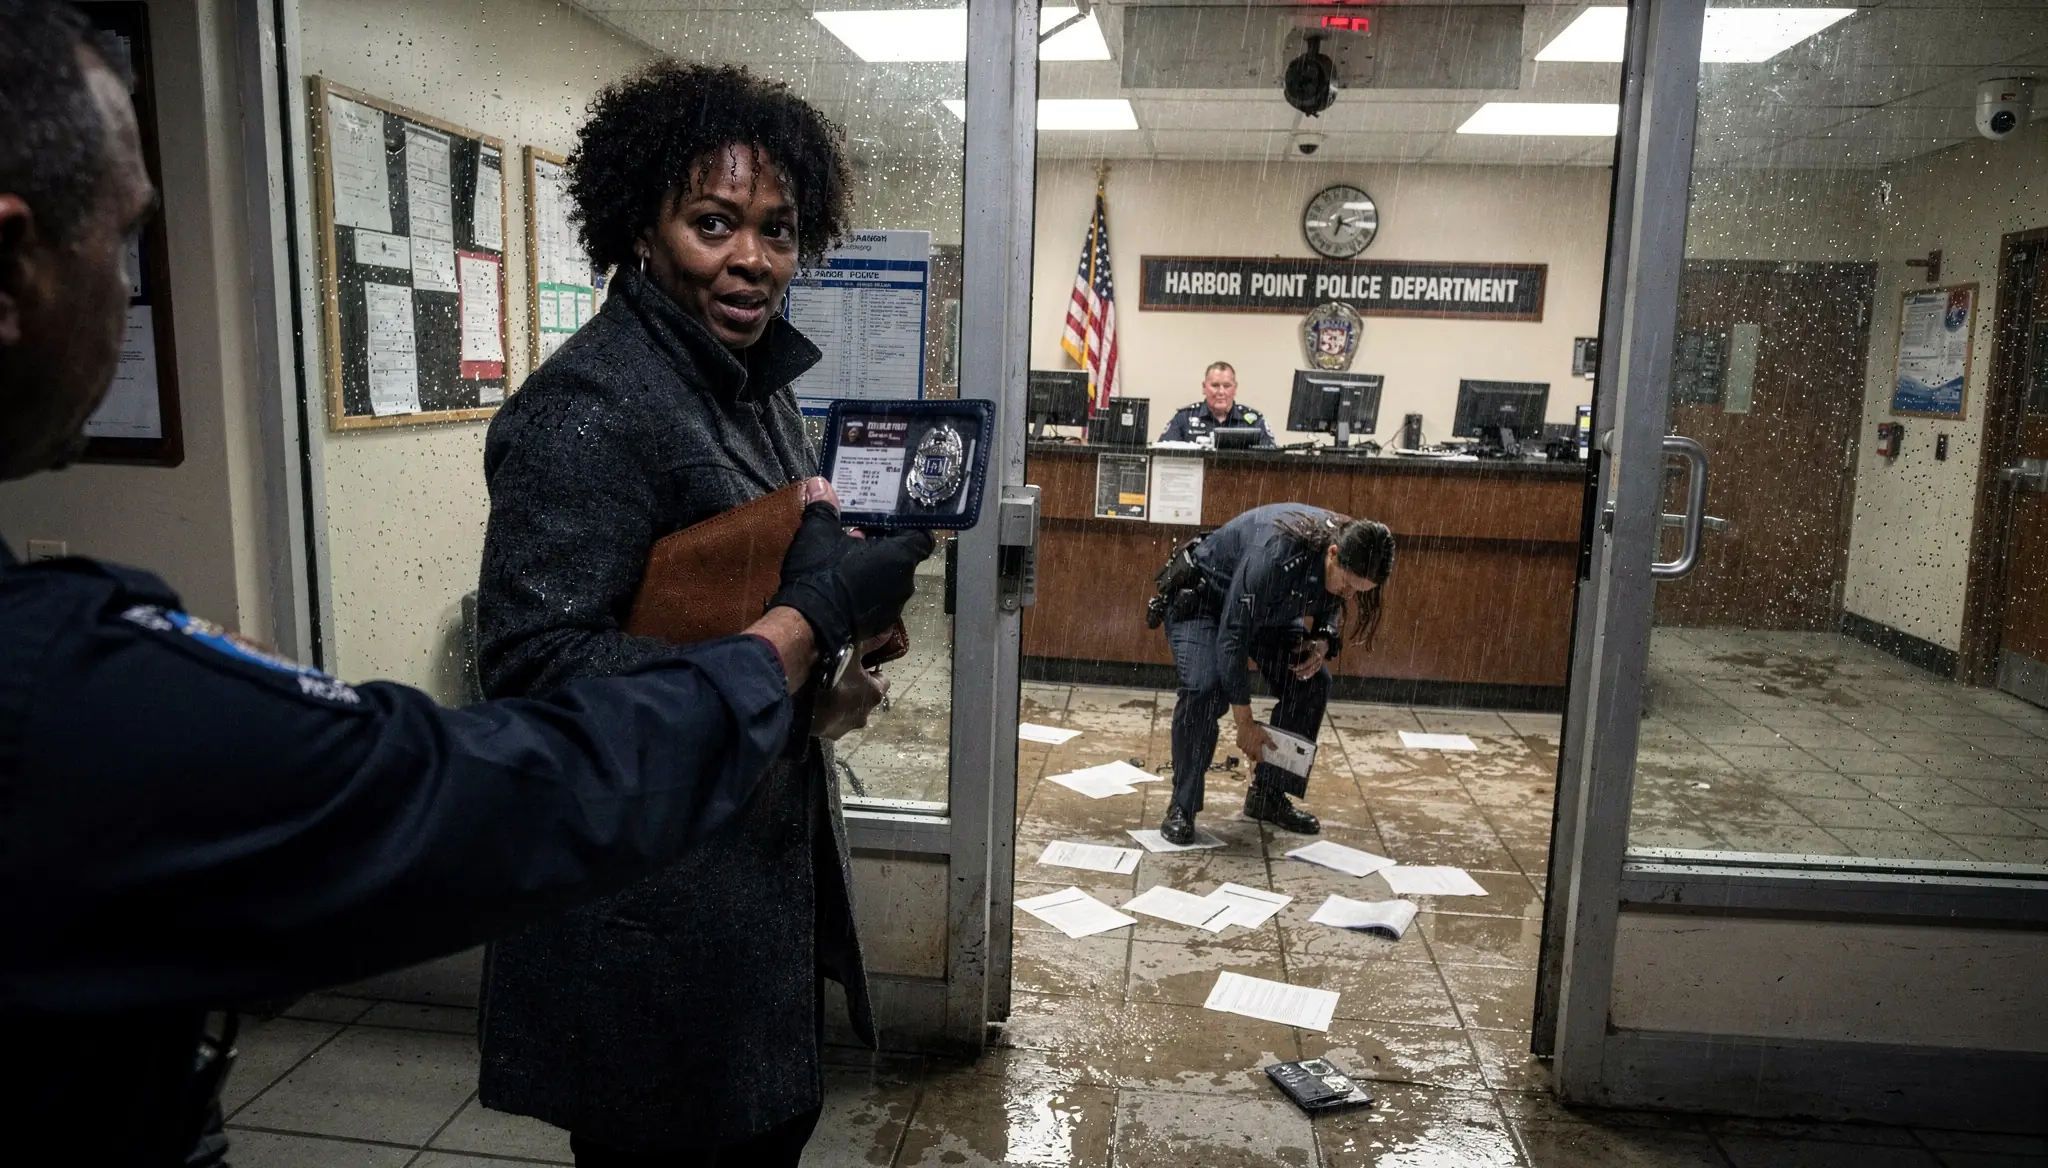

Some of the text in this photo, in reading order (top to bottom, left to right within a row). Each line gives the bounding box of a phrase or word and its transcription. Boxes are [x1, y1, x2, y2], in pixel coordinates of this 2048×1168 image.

[1166, 272, 1519, 303] HARBOR POINT POLICE DEPARTMENT
